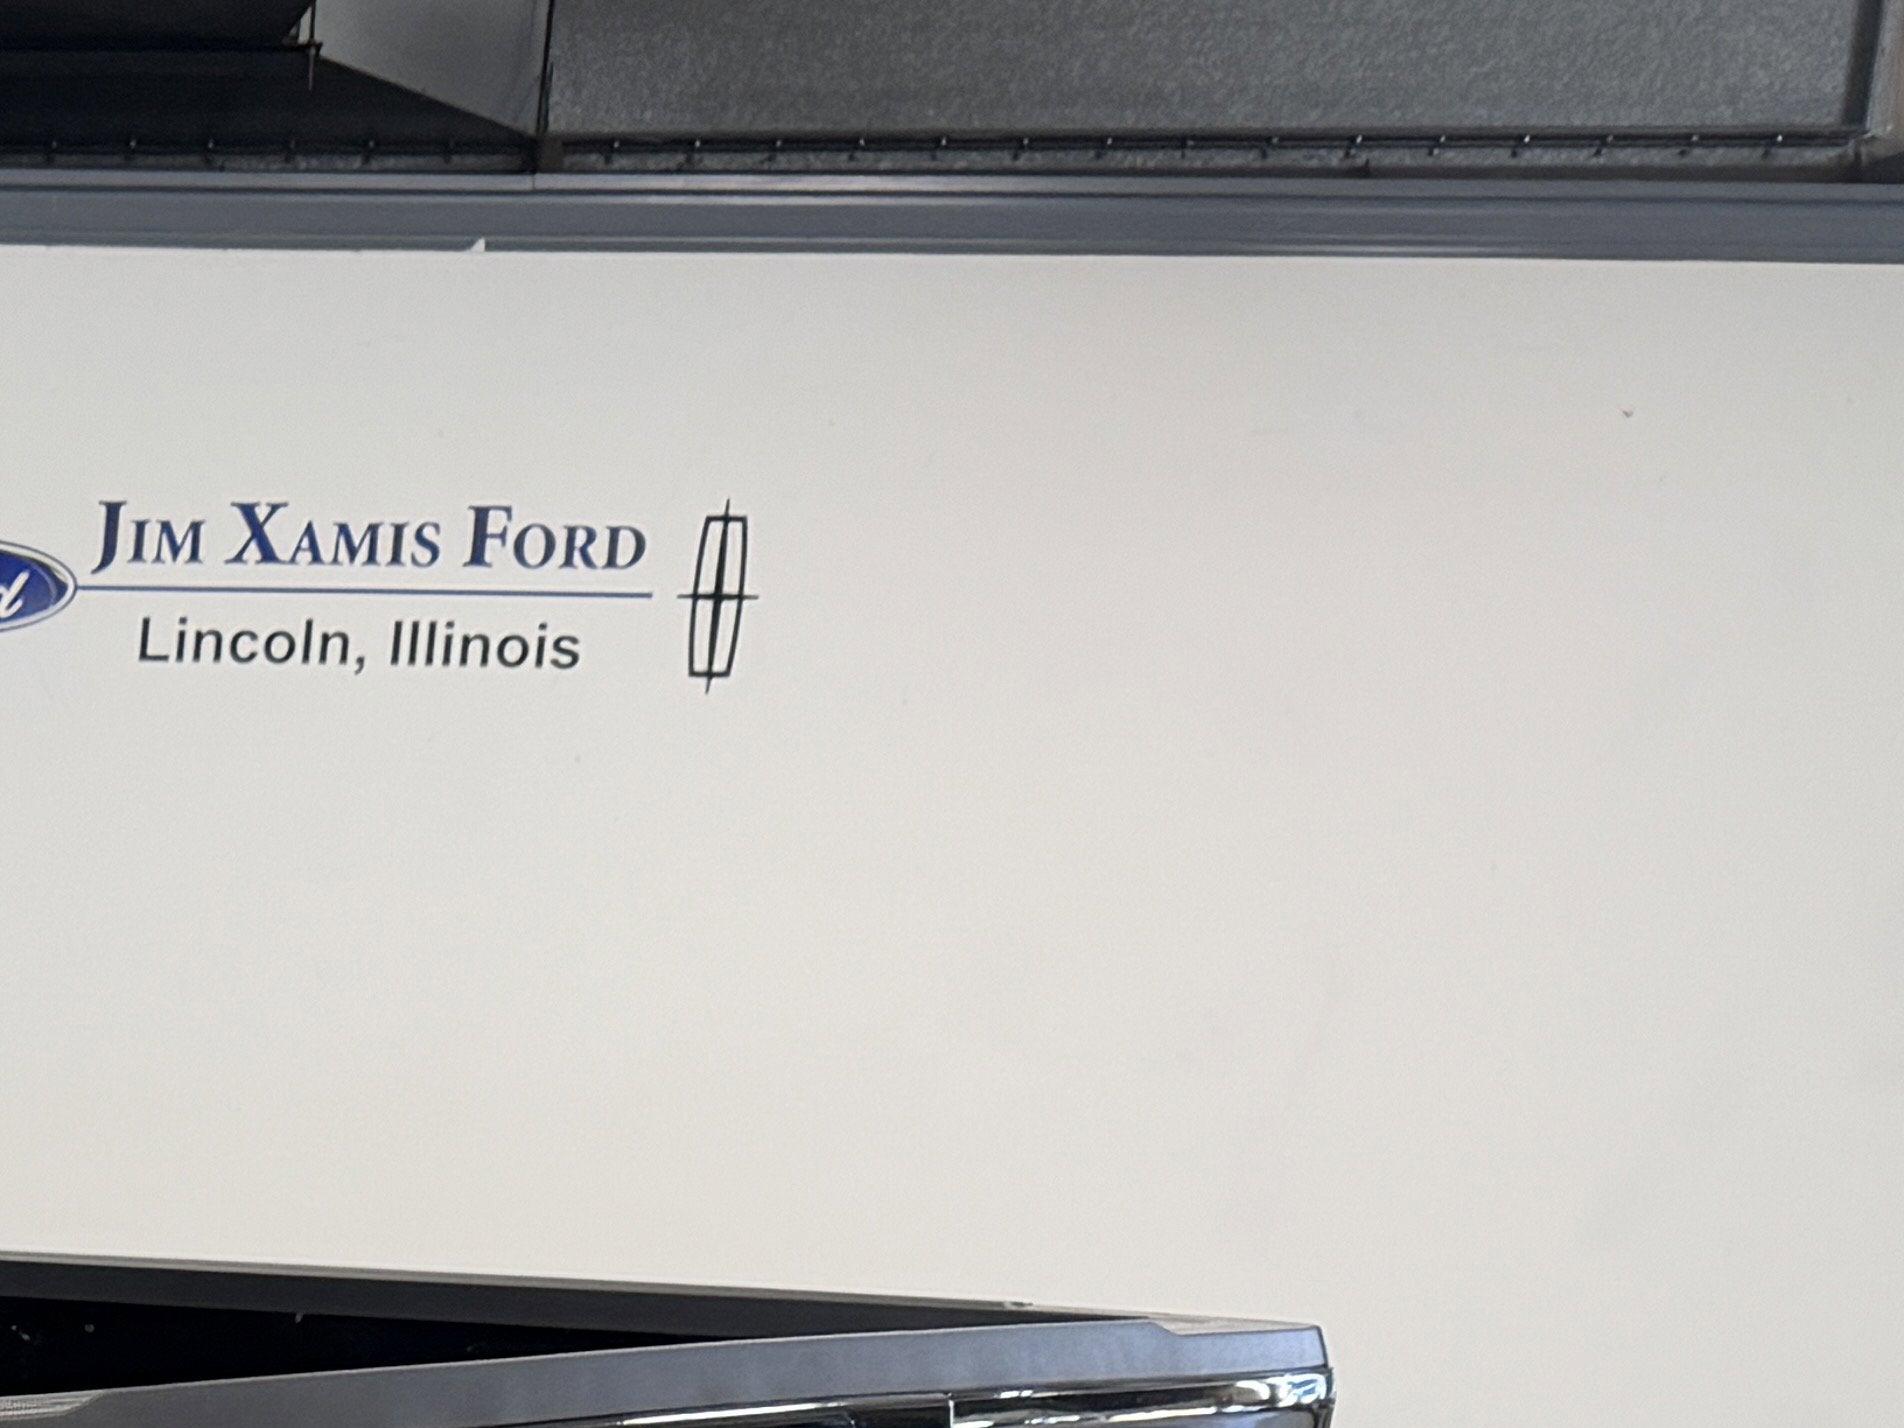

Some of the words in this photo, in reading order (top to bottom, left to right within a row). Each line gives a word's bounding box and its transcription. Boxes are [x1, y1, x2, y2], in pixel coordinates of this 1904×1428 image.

[90, 500, 205, 576] JIM
[225, 502, 442, 570] XAMIS
[462, 505, 648, 574] FORD
[138, 617, 366, 674] Lincoln,
[389, 620, 582, 671] Illinois
